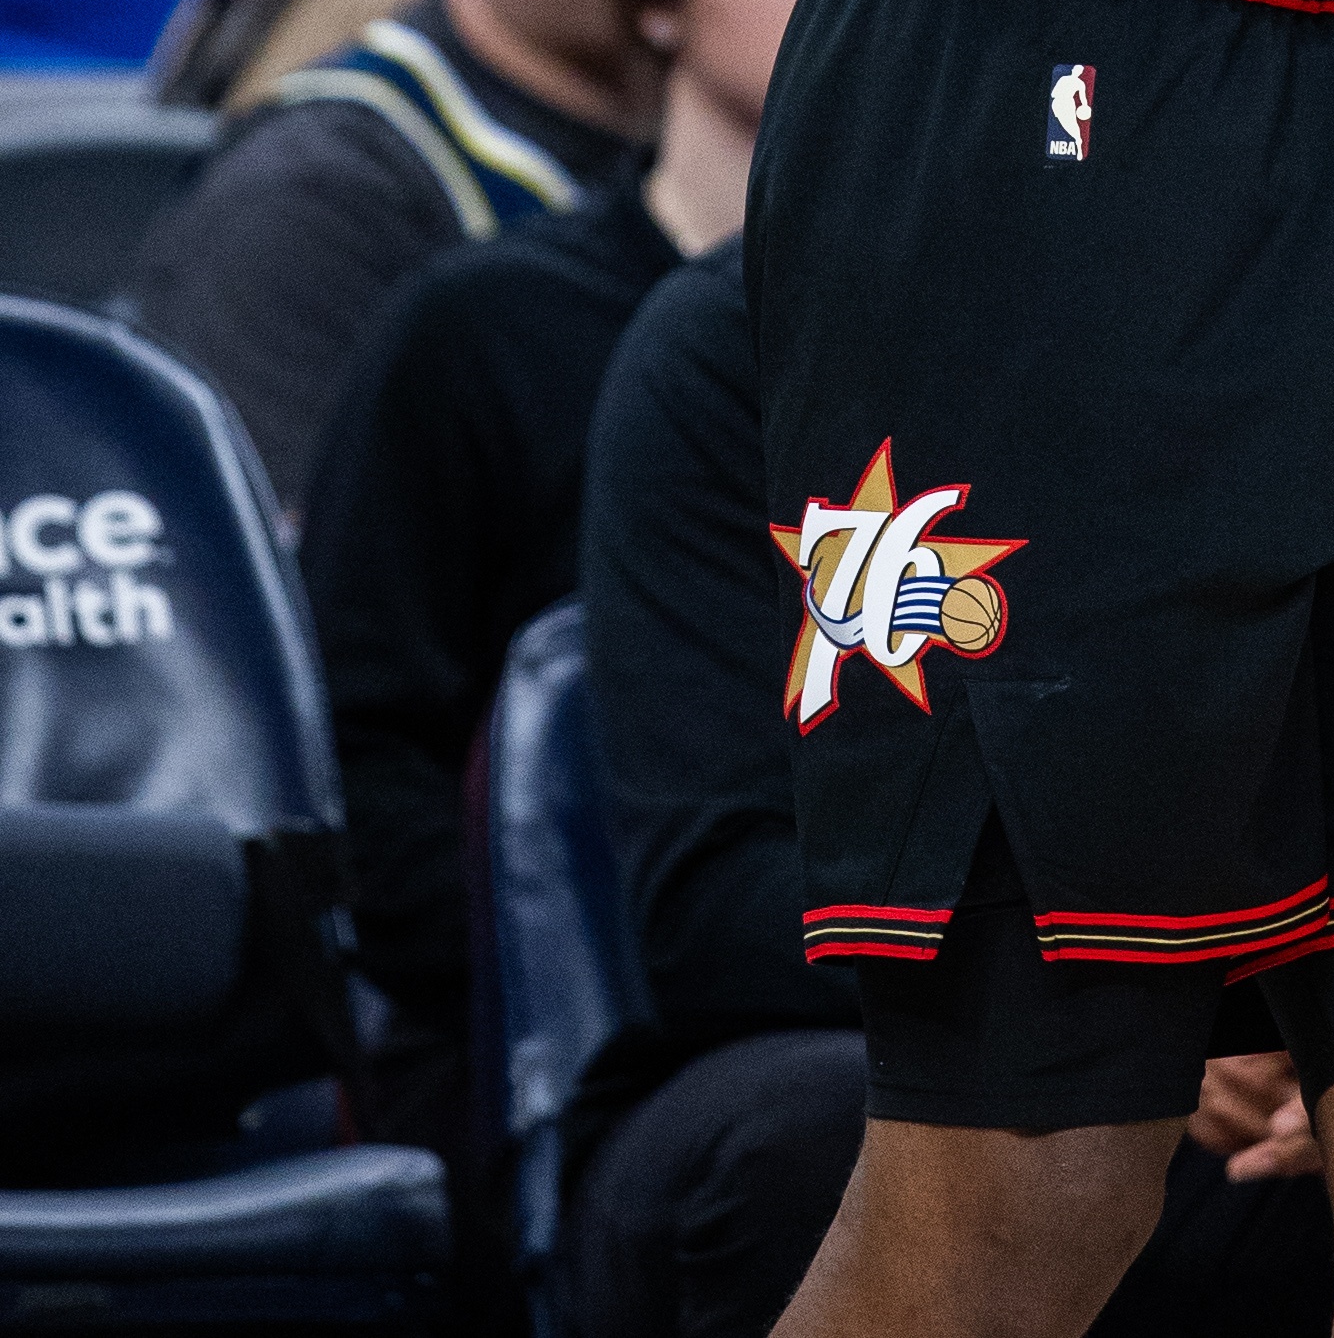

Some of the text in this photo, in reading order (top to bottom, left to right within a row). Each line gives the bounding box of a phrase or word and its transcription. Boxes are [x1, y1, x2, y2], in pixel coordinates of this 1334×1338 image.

[1049, 140, 1077, 156] NBA
[0, 490, 164, 574] ce
[797, 483, 971, 729] 76
